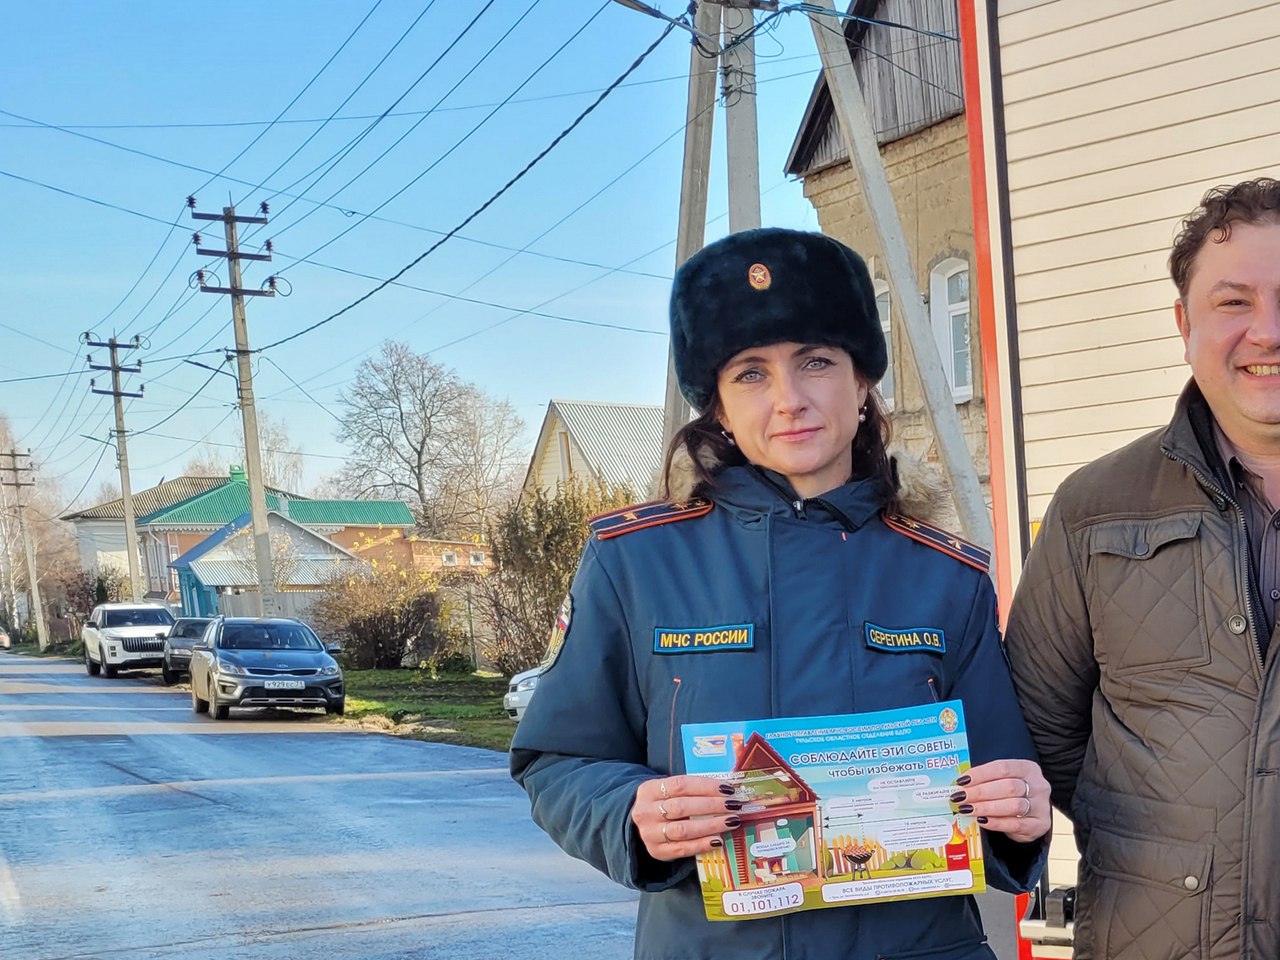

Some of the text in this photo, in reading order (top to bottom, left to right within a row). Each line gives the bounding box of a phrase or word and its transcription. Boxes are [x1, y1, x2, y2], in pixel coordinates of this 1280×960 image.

[660, 628, 748, 648] МЧС РОССИИ
[870, 628, 941, 648] СЕРЕГИНА О.В.
[791, 740, 956, 764] СОБЛЮДАЙТЕ ЭТИ СОВЕТЫ,
[829, 755, 958, 778] чтобы избежать БЕДЫ
